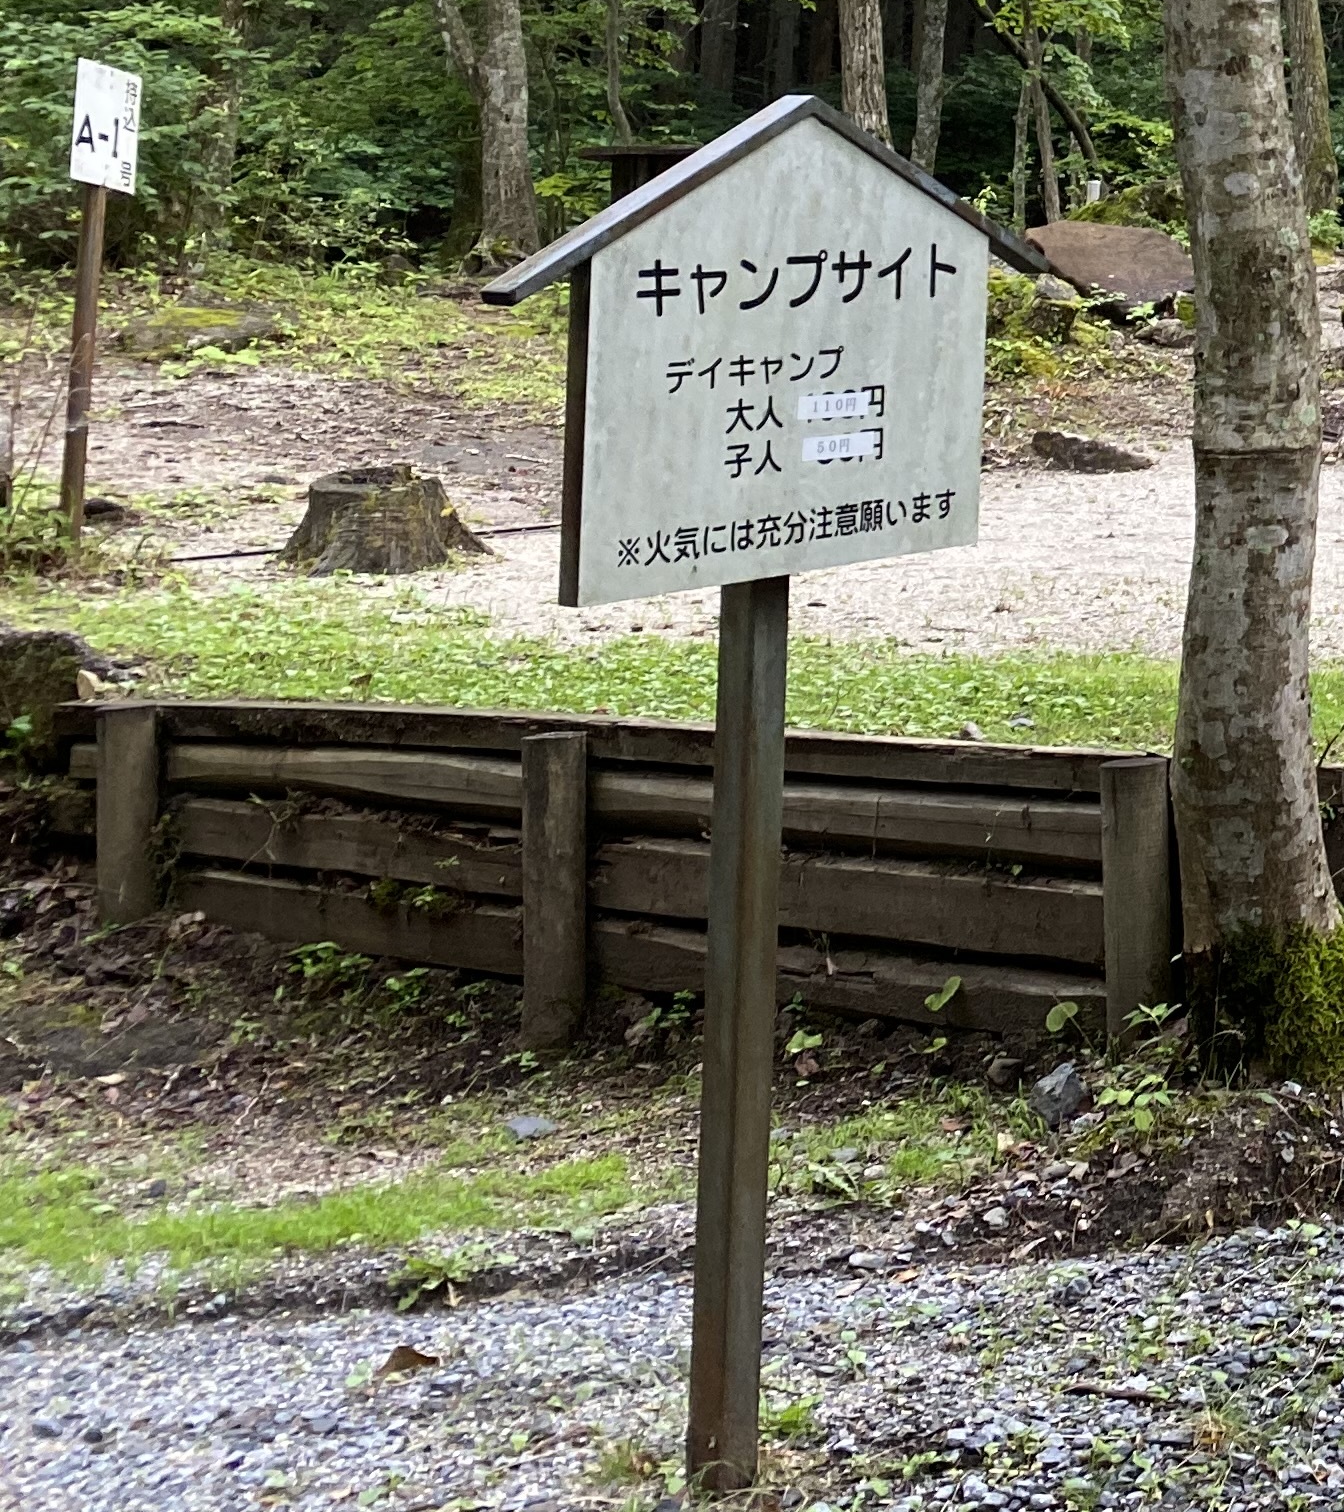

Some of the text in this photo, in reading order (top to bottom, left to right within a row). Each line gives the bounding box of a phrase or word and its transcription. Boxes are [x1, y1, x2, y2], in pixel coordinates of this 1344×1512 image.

[75, 113, 119, 159] A-1
[636, 243, 958, 317] キャンプサイト
[665, 345, 845, 394] デイキャンプ
[725, 395, 783, 434] 大人
[813, 397, 857, 414] 110円
[724, 439, 782, 478] 子人
[816, 437, 851, 454] 50円
